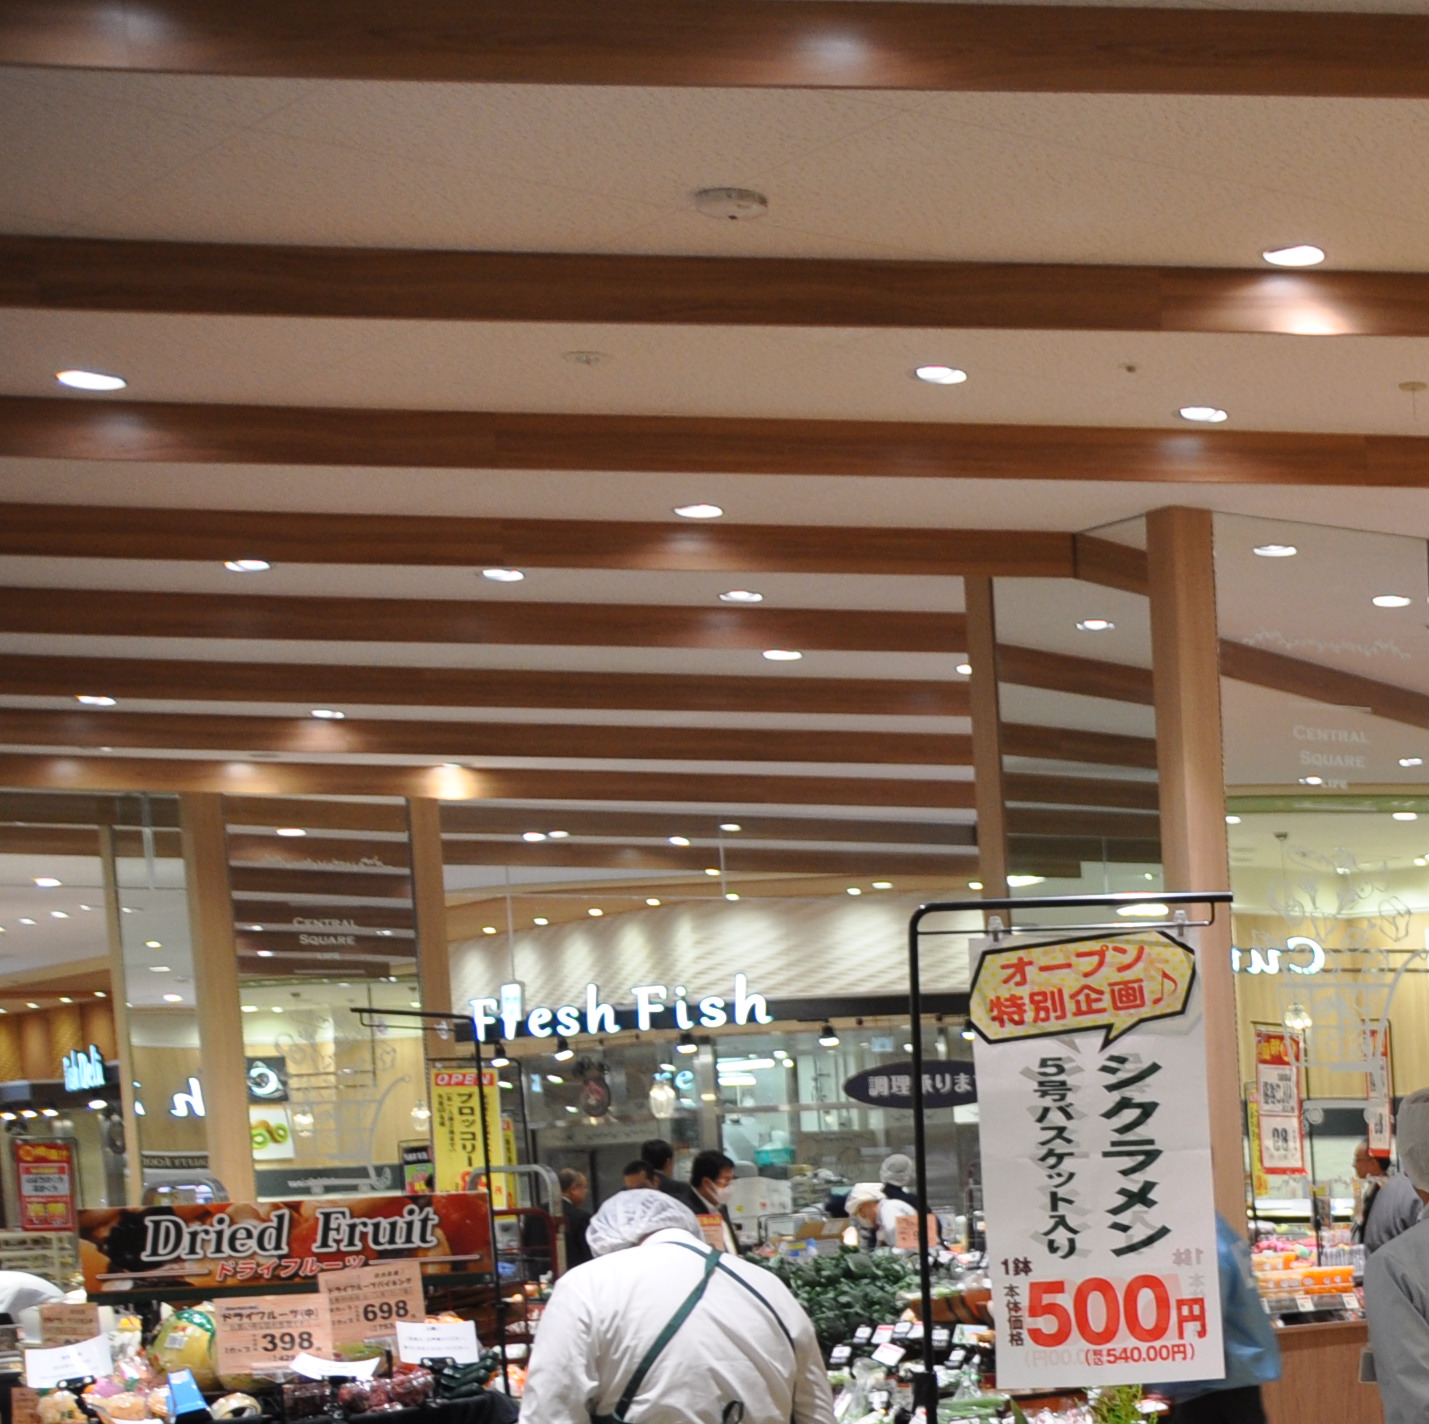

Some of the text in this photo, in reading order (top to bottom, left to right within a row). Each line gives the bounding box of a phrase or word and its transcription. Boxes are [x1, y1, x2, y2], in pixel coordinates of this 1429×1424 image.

[1293, 725, 1371, 744] CENTRAL
[1300, 750, 1365, 768] SQUARE
[292, 916, 359, 929] CENTRAL
[299, 934, 356, 946] SQUARE
[1000, 944, 1145, 987] オープン
[631, 972, 773, 1031] Fish
[988, 978, 1147, 1028] 特別企画
[436, 1074, 492, 1086] OPEN
[868, 1073, 976, 1097] 調理承りま
[1033, 1057, 1080, 1259] 5号バスケット入り
[1098, 1054, 1171, 1257] シクラメン
[141, 1204, 440, 1261] Dried Fruit
[215, 1255, 366, 1282] ドライフルーツ
[363, 1300, 409, 1322] 698
[1003, 1284, 1024, 1347] 本体価格
[261, 1331, 314, 1352] 398
